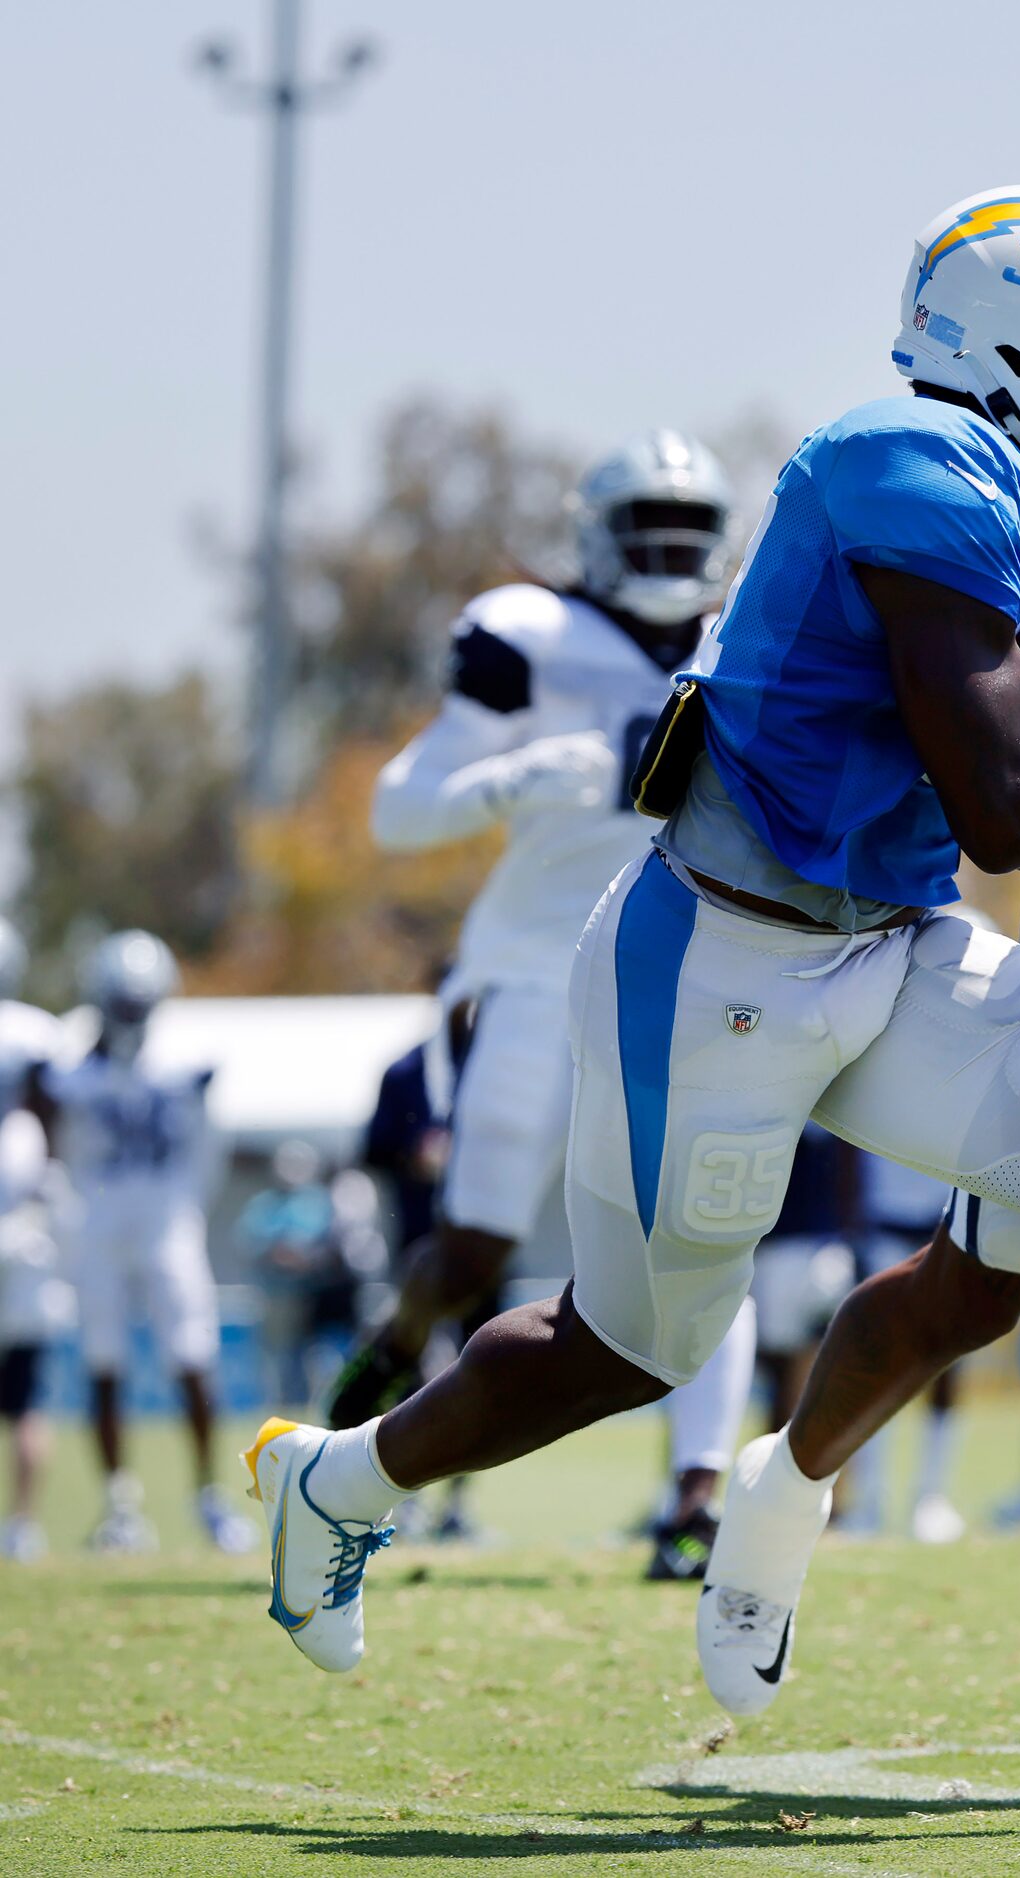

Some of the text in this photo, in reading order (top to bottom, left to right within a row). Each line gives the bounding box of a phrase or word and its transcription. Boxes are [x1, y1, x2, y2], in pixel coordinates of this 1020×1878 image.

[728, 1006, 759, 1015] EQUIPMENT
[735, 1020, 750, 1031] NFL
[695, 1143, 788, 1218] 35
